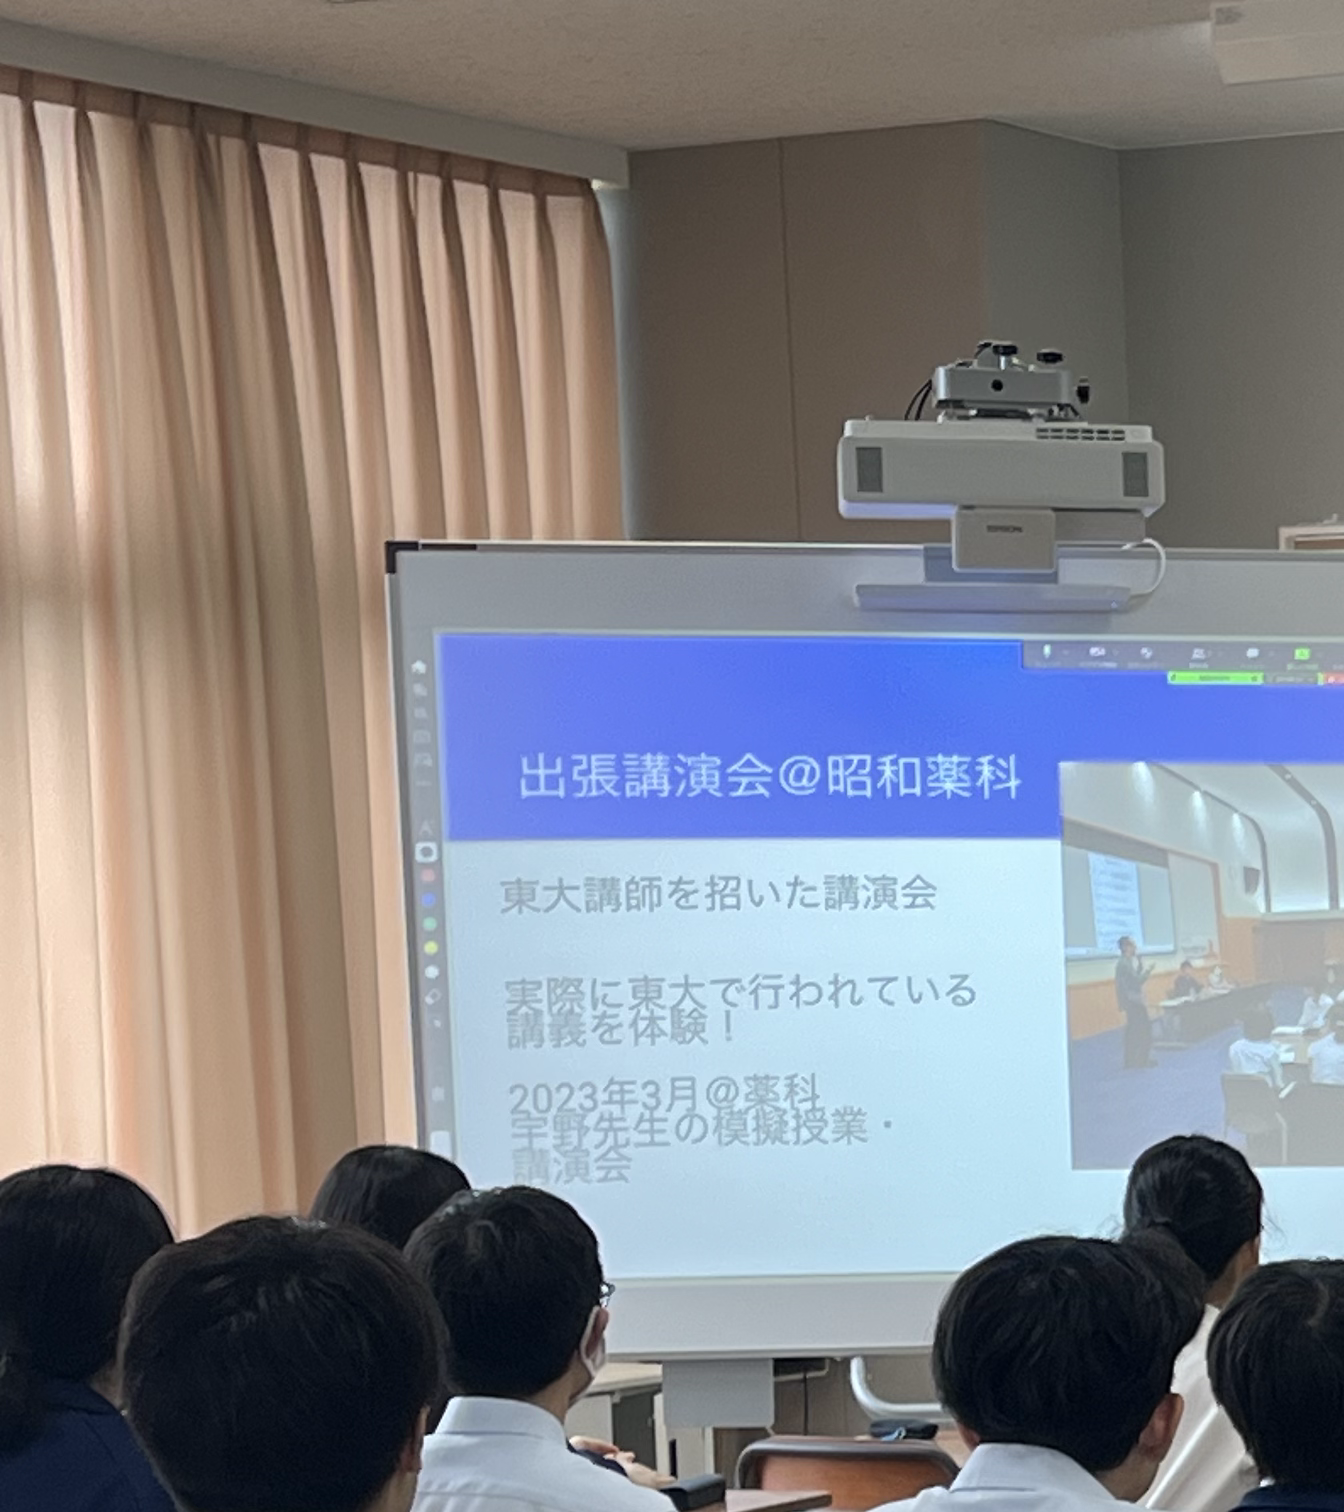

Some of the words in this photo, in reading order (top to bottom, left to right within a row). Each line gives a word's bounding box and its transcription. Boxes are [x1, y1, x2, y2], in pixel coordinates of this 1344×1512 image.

[518, 751, 1021, 800] 出張講演会@昭和薬科
[499, 873, 938, 915] 東大講師を招いた講演会
[503, 971, 978, 1015] 実際に東大で行われている
[508, 1072, 821, 1116] 2023年3月@薬科
